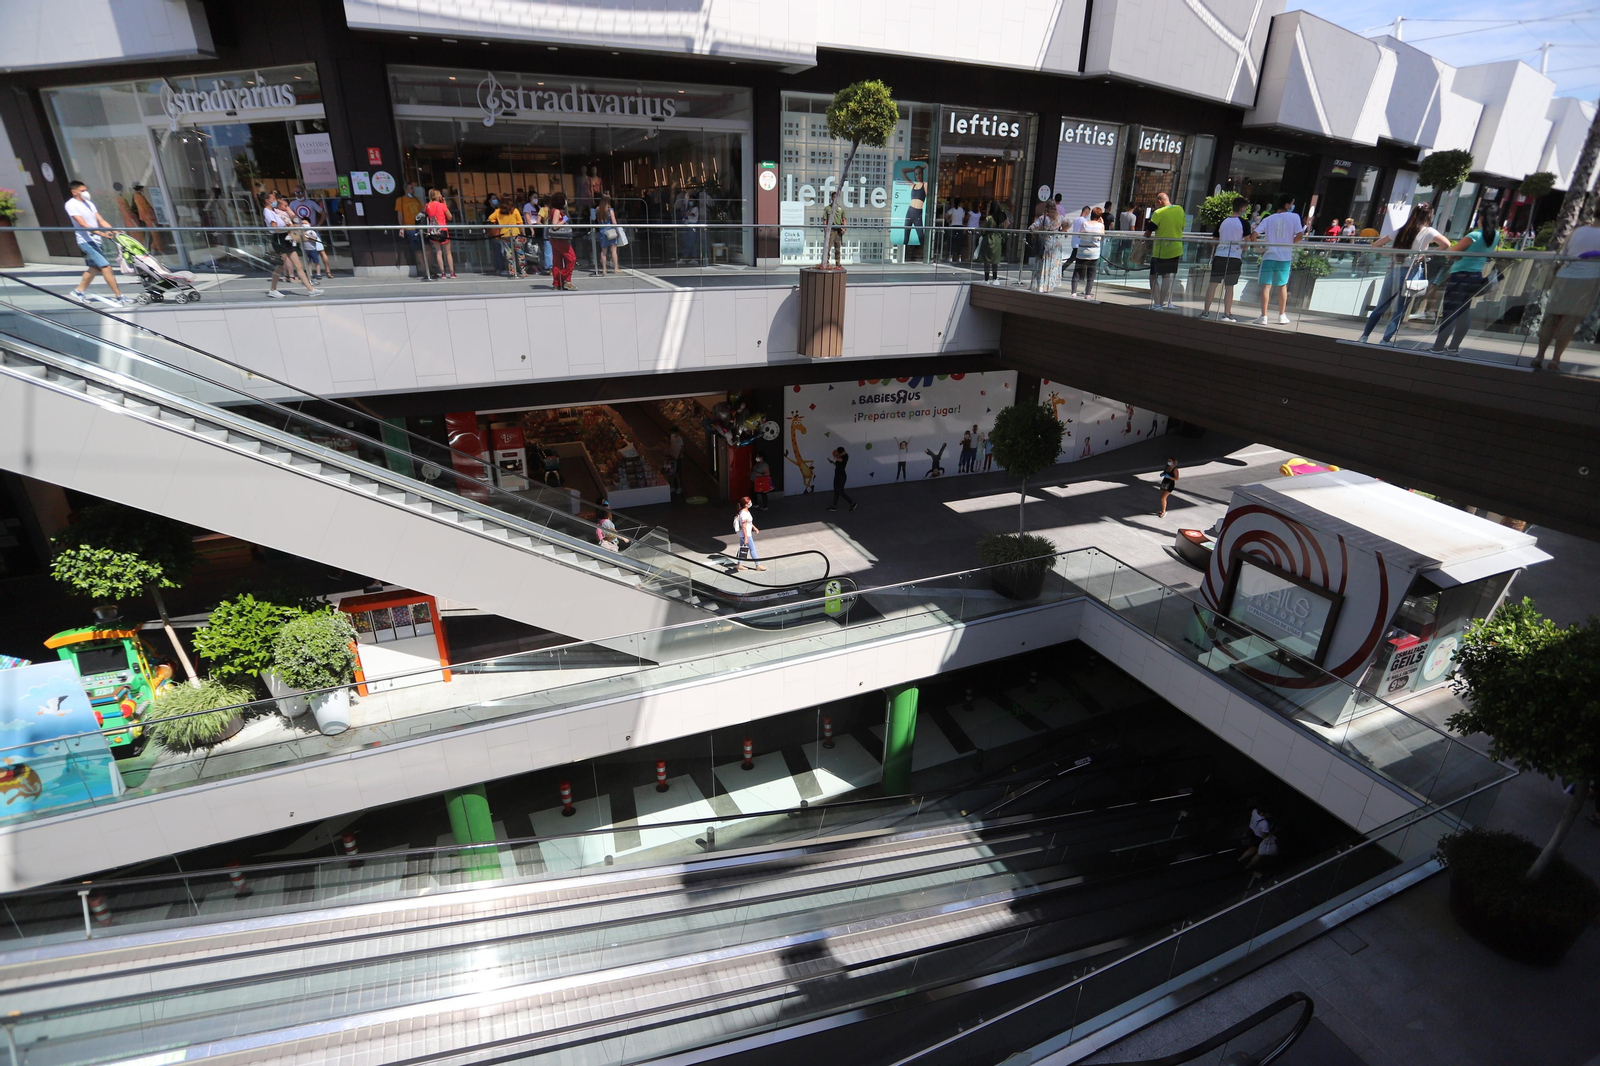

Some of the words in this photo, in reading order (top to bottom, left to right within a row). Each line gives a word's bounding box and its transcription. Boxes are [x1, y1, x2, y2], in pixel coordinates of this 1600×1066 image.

[173, 76, 297, 114] stradivarius
[501, 83, 676, 118] stradivarius
[949, 112, 1020, 138] lefties
[1060, 122, 1115, 146] lefties
[1139, 131, 1183, 154] lefties
[854, 410, 906, 423] ¡Prepárate
[909, 408, 931, 420] para
[932, 405, 961, 418] jugar!
[1249, 595, 1305, 627] FACTORY
[1390, 651, 1425, 672] GEILS
